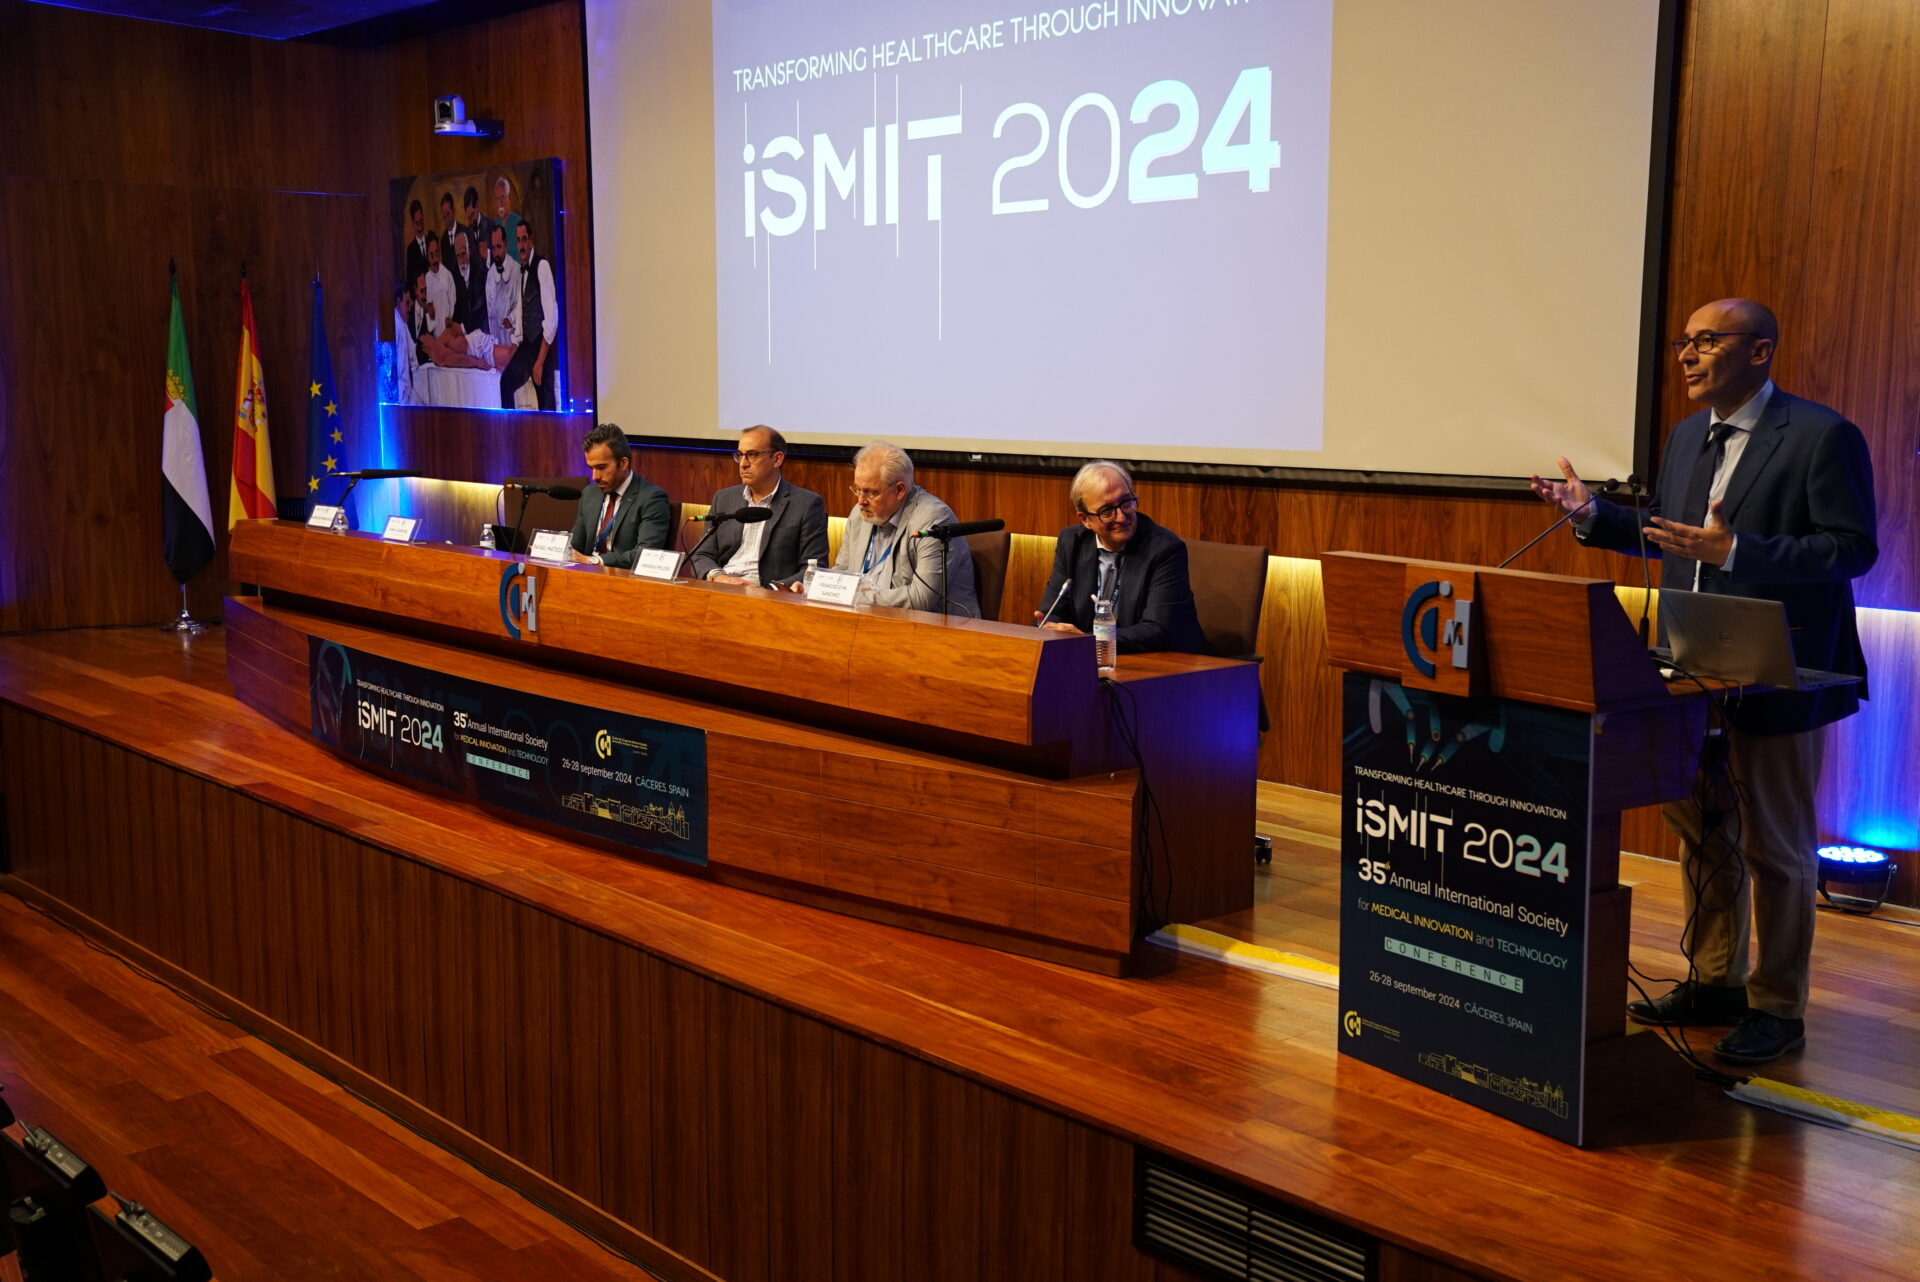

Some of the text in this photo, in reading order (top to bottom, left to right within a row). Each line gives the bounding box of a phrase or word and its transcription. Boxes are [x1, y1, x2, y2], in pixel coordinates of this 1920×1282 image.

[733, 47, 867, 93] TRANSFORMING
[872, 20, 1004, 69] HEALTHCARE
[1009, 0, 1119, 44] THROUGH
[991, 66, 1281, 215] 2024
[400, 714, 444, 753] 2024
[460, 734, 479, 747] MEDICAL
[479, 740, 507, 754] INNOVATION
[508, 748, 516, 757] and
[517, 750, 549, 765] TECHNOLOGY
[467, 718, 488, 733] Annual
[488, 723, 525, 743] International
[525, 734, 548, 752] Society
[466, 754, 529, 779] CONFERENCE
[562, 758, 580, 772] 26-28
[580, 764, 614, 780] september
[615, 771, 632, 784] 2024
[669, 784, 689, 798] SPAIN
[1354, 765, 1567, 820] TRANSFORMING HEALTHCARE THROUGH INNOVATION
[1463, 822, 1570, 884] 2024
[1389, 871, 1431, 896] Annual
[1434, 883, 1514, 919] International
[1517, 906, 1569, 938] Society
[1357, 897, 1569, 970] for MEDICAL INNOVATION and TECHNOLOGY
[1385, 938, 1523, 992] CONFERENCE
[1369, 970, 1392, 987] 26-28
[1393, 980, 1437, 1001] september
[1438, 993, 1461, 1009] 2024
[1506, 1016, 1533, 1035] SPAIN
